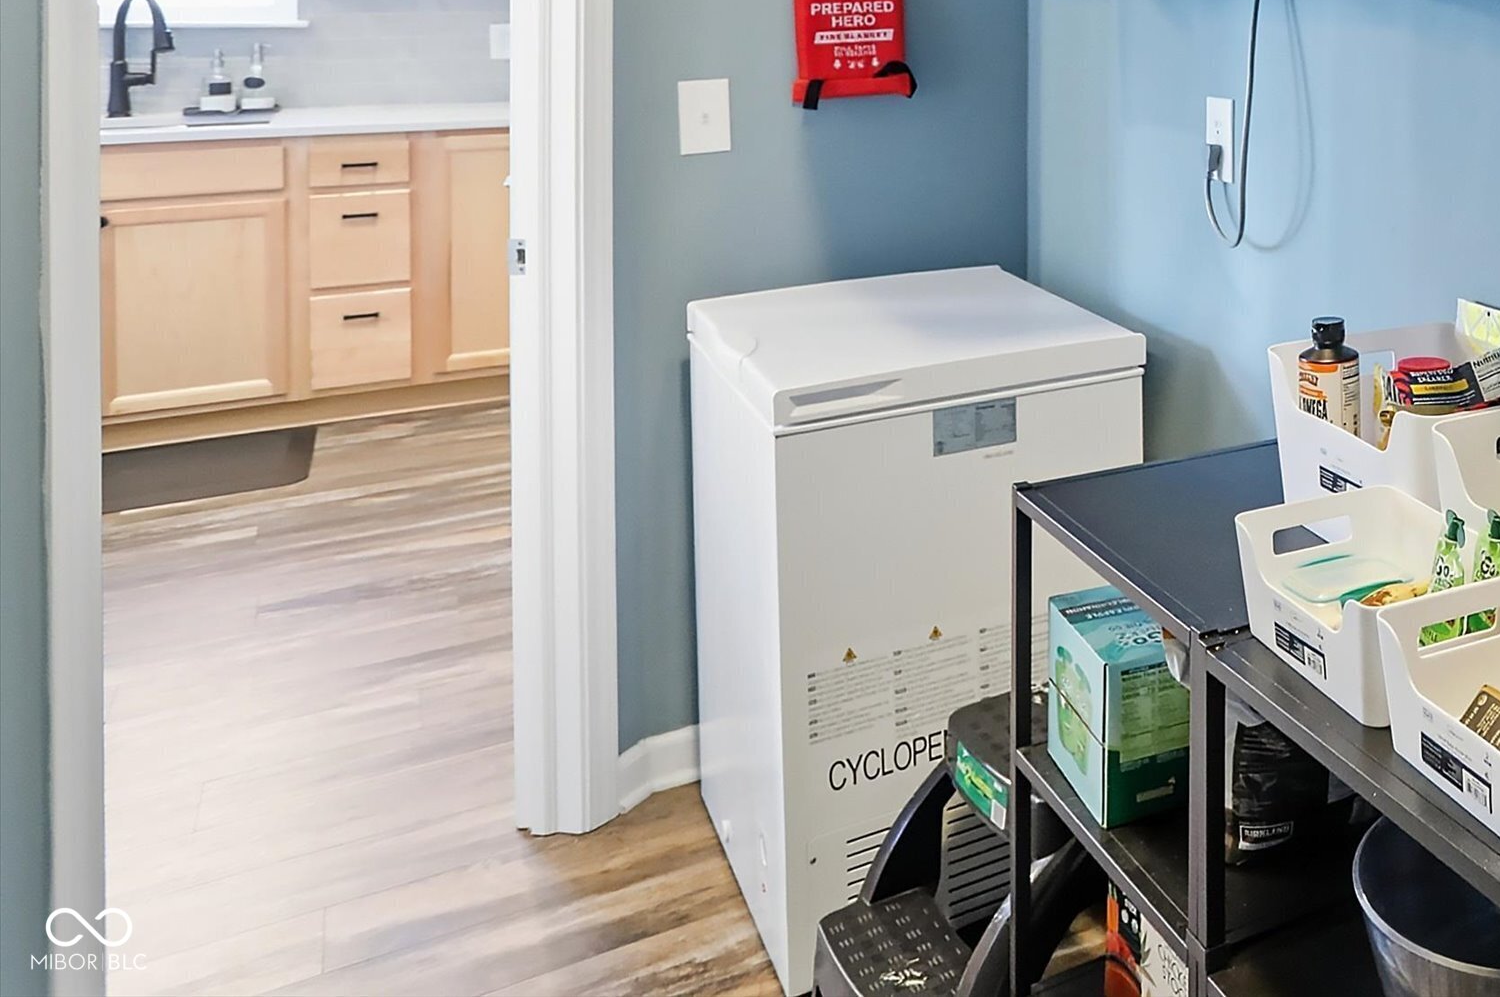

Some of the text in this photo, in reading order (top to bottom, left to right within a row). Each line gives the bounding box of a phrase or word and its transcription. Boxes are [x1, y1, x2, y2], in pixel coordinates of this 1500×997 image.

[810, 0, 895, 17] PREPARED
[831, 13, 877, 28] HERO
[820, 30, 888, 41] FIRE BLANKET
